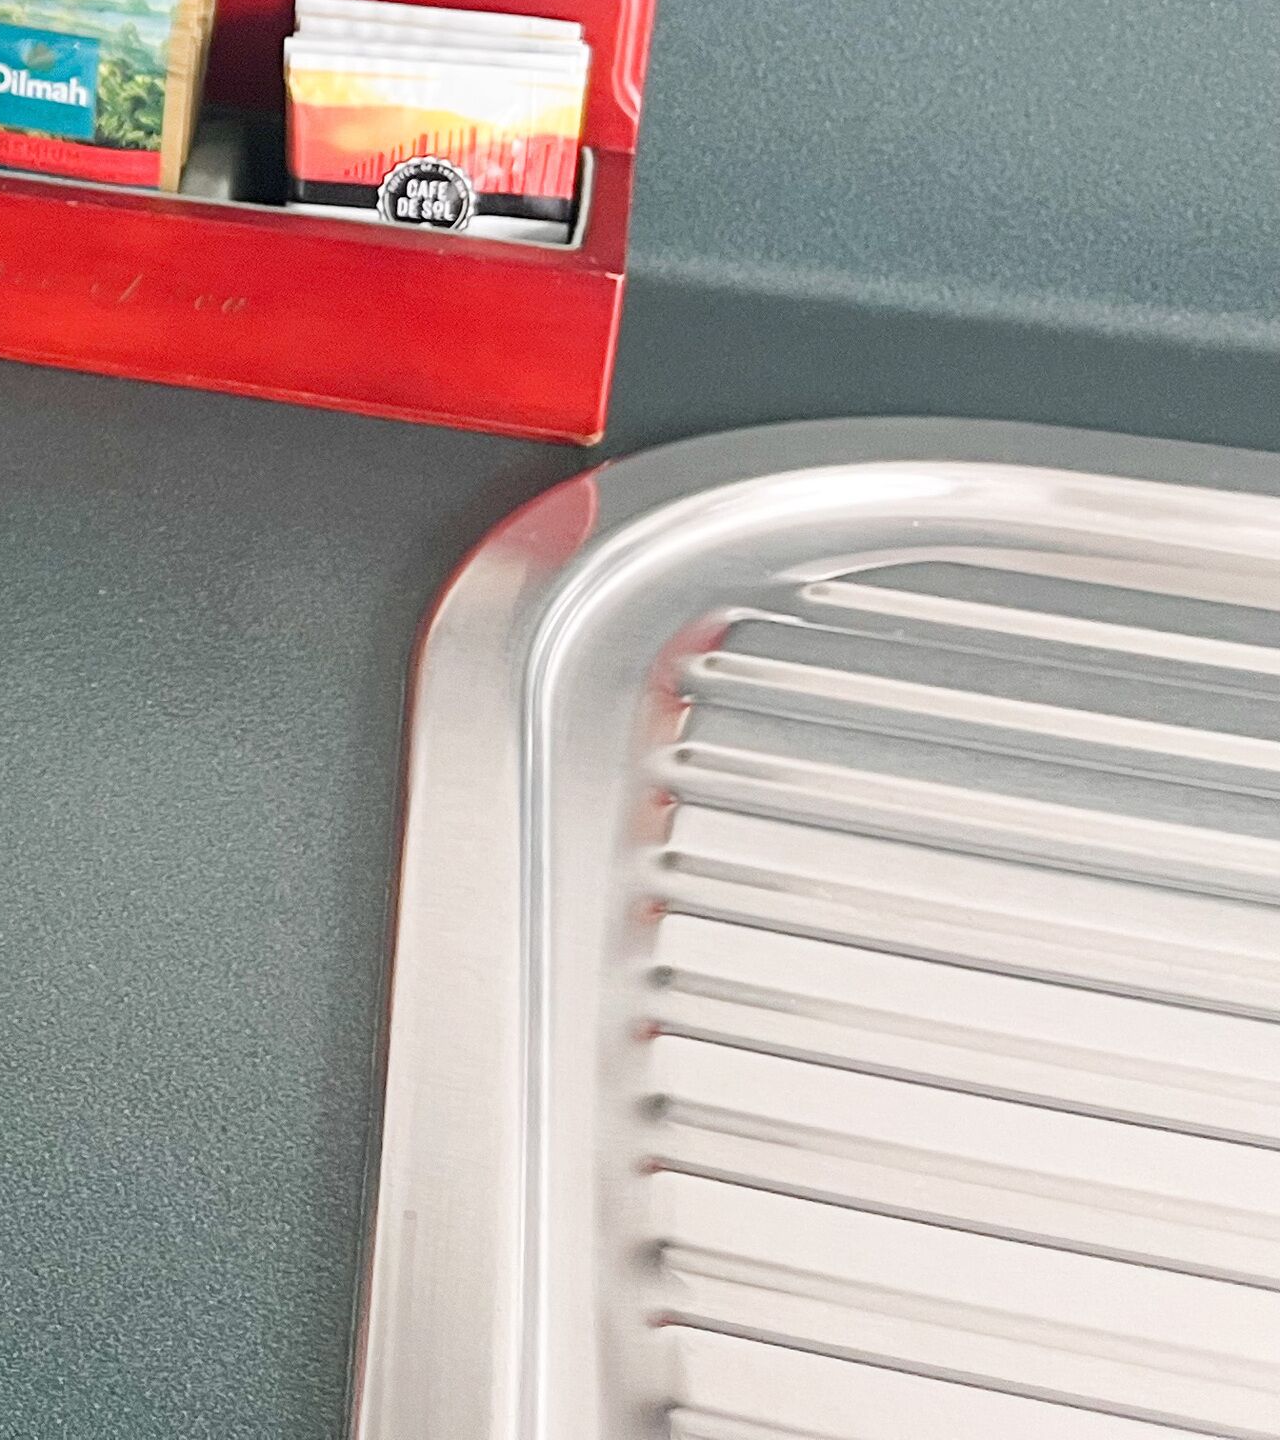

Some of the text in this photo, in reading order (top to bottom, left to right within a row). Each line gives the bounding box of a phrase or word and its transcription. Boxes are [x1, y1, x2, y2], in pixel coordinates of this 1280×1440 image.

[406, 178, 449, 200] CAFE
[396, 196, 456, 221] DE SOL
